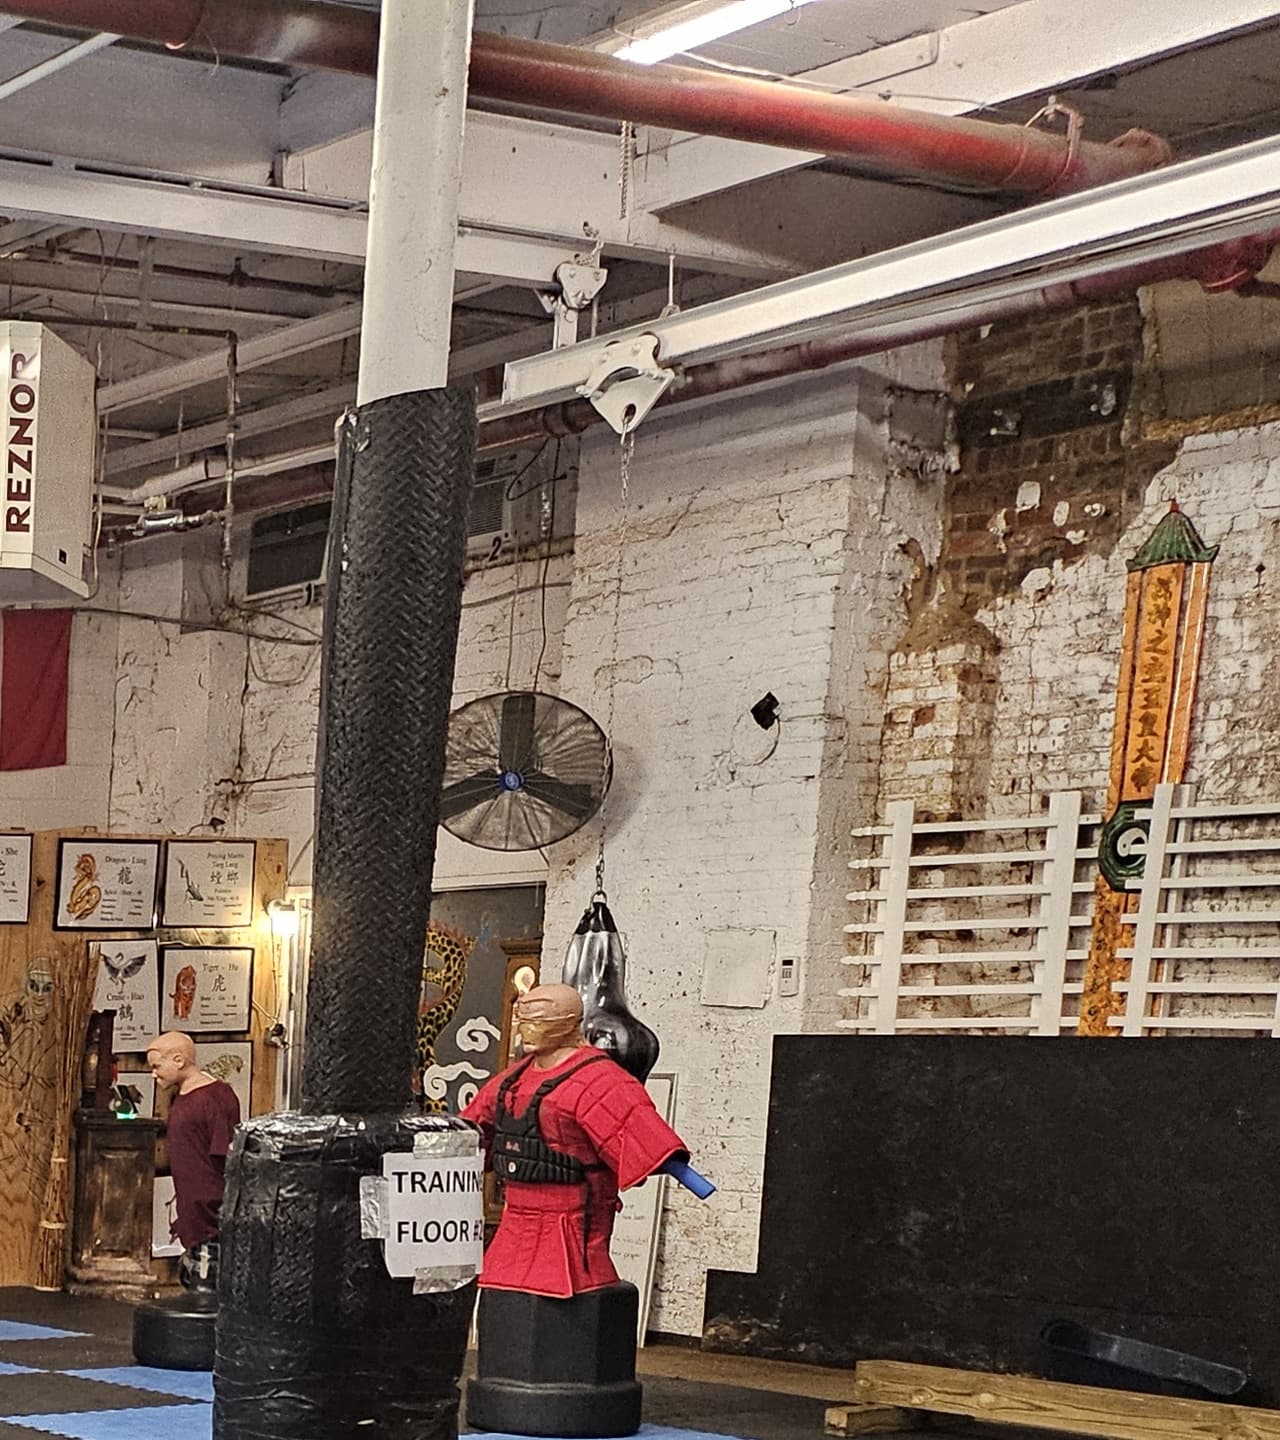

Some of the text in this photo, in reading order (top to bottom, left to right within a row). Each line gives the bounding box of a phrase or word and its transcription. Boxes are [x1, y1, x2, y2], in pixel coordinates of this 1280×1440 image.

[5, 351, 37, 533] REZNOR
[392, 1171, 484, 1194] TRAININ
[397, 1220, 469, 1243] FLOOR
